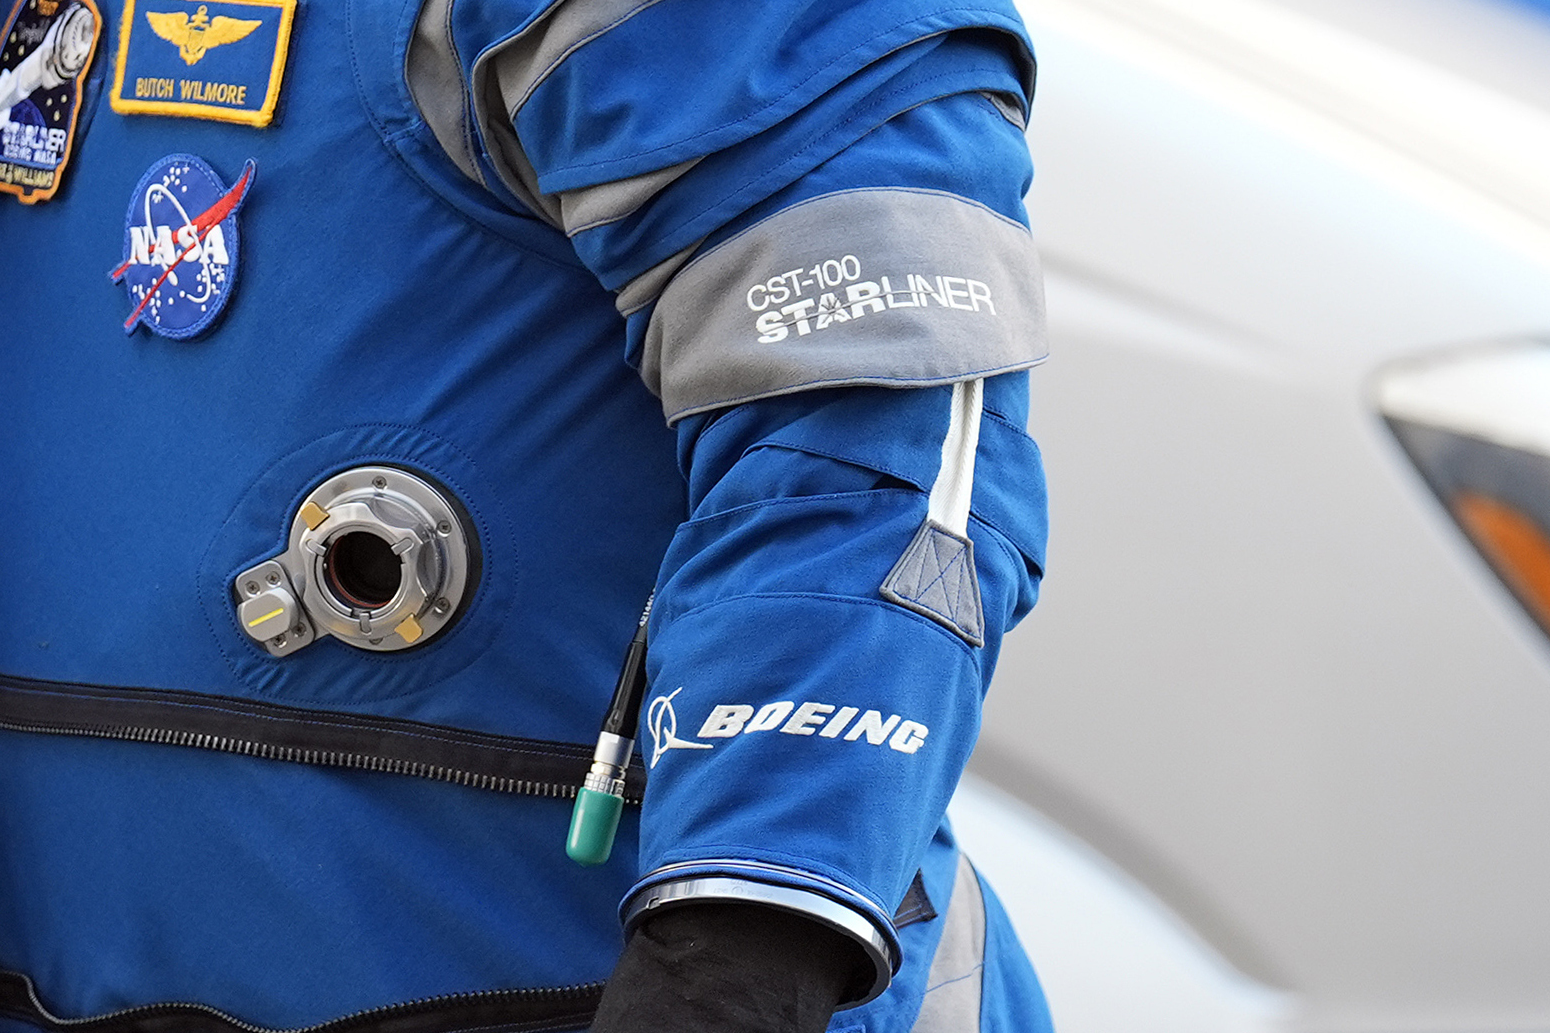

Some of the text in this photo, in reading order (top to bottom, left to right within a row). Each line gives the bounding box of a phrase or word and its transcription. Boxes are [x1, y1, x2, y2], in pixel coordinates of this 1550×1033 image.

[135, 77, 247, 105] BUTCH WILMORE
[129, 224, 229, 265] NASA
[746, 254, 861, 312] CST-100
[755, 275, 997, 345] STARLINER
[697, 701, 929, 755] BOEING
